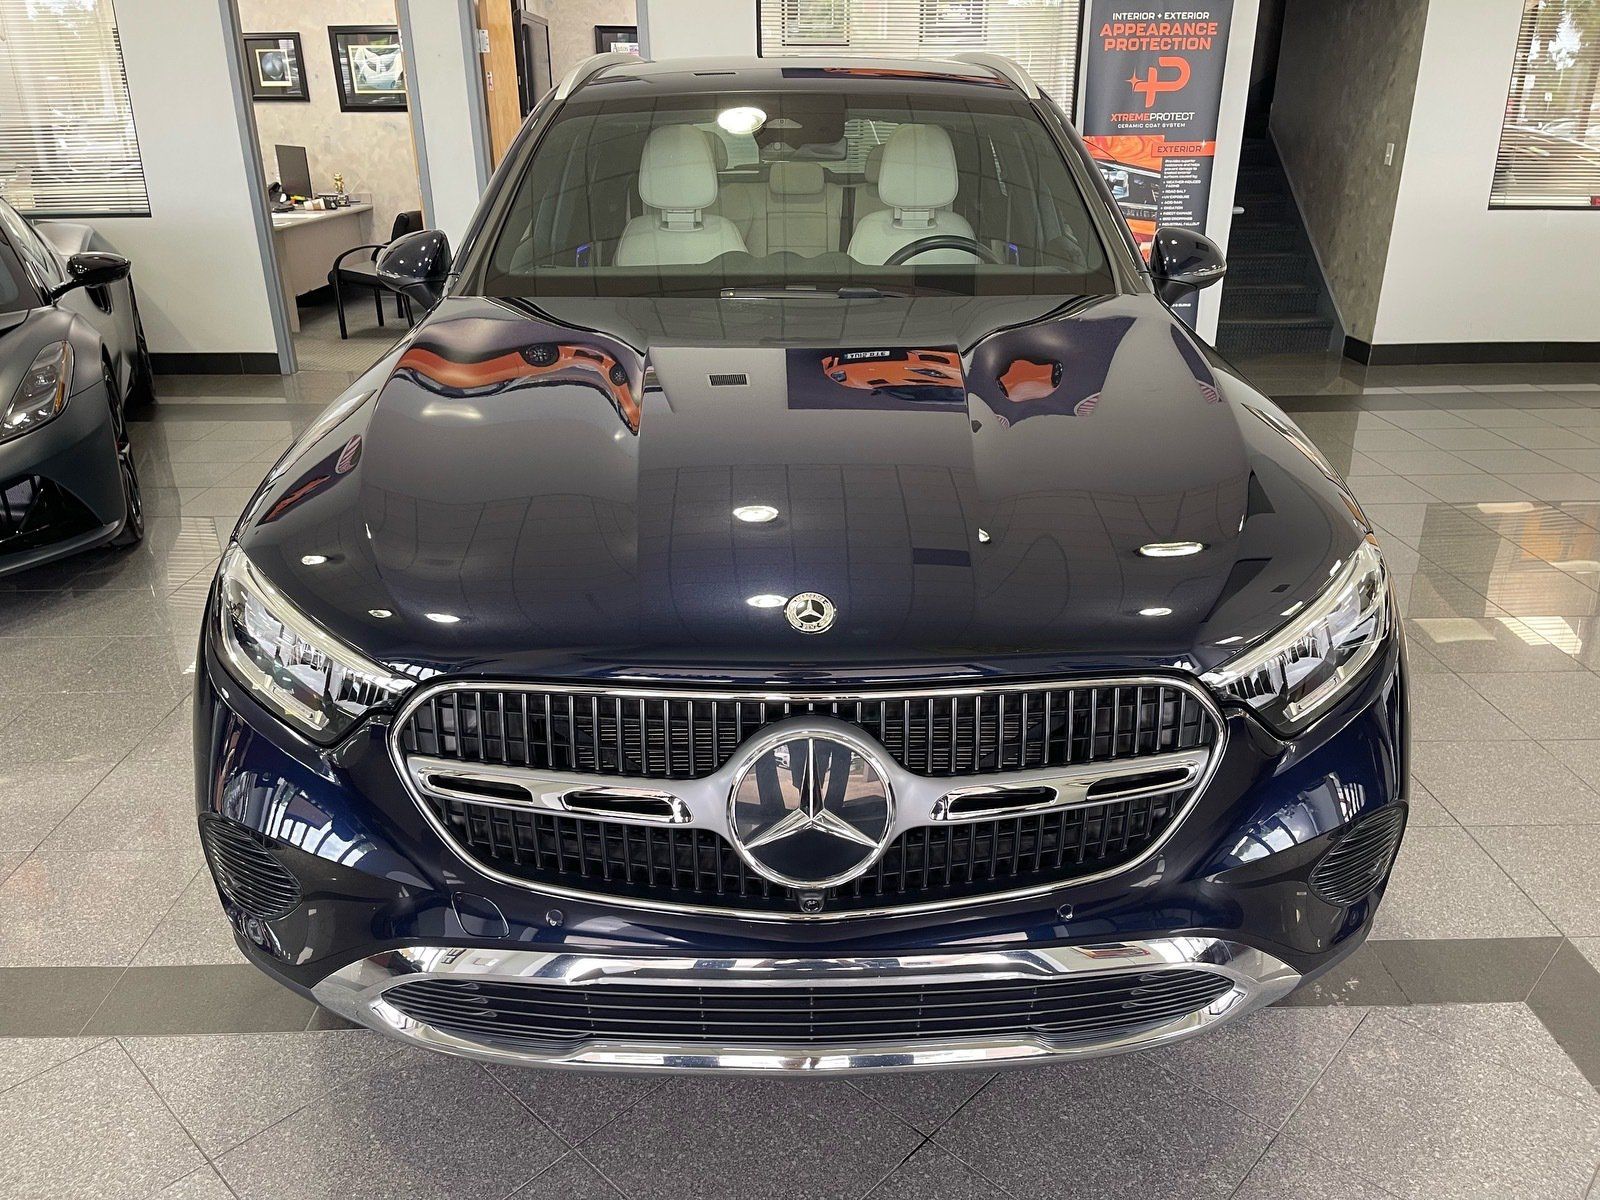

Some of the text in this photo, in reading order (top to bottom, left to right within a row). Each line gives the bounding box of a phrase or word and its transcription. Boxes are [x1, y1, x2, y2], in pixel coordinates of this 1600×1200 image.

[1112, 12, 1155, 20] INTERIOR
[1164, 11, 1210, 20] EXTERIOR
[1099, 22, 1218, 37] APPEARANCE
[1104, 37, 1212, 51] PROTECTION
[1110, 112, 1195, 122] XTREMEPROTECT
[1157, 145, 1202, 153] EXTERIOR
